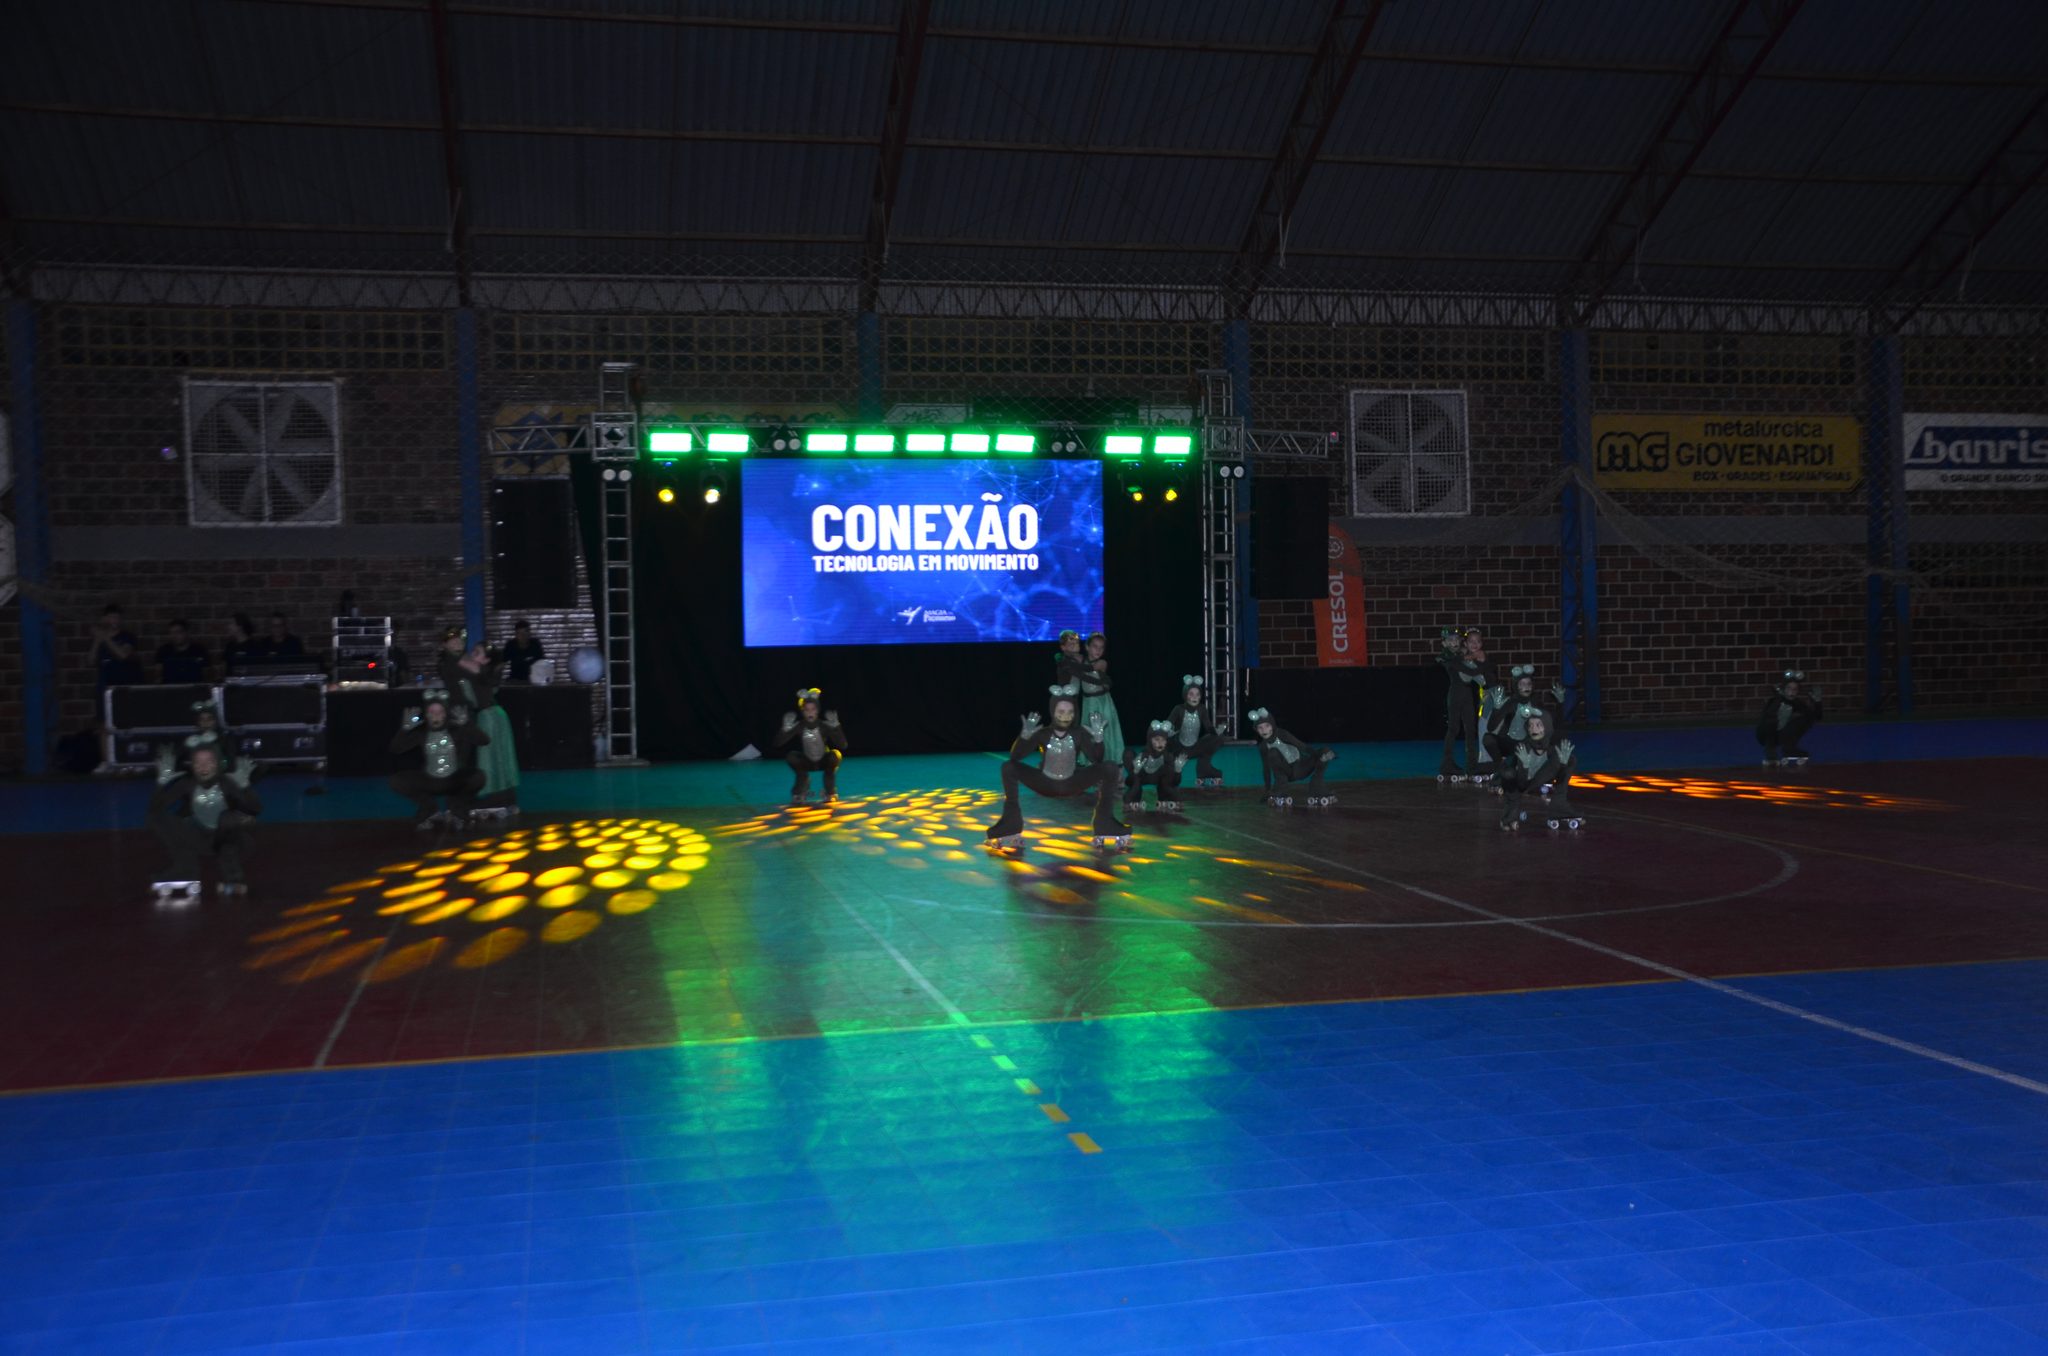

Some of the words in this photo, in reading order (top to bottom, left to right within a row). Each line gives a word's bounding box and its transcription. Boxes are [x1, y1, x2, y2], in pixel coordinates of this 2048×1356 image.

[1693, 471, 1719, 481] BOX
[812, 492, 1038, 552] CONEXÃO
[812, 555, 915, 573] TECNOLOGIA
[918, 555, 942, 571] EM
[945, 554, 1039, 571] MOVIMENTO
[1328, 571, 1349, 653] CRESOL
